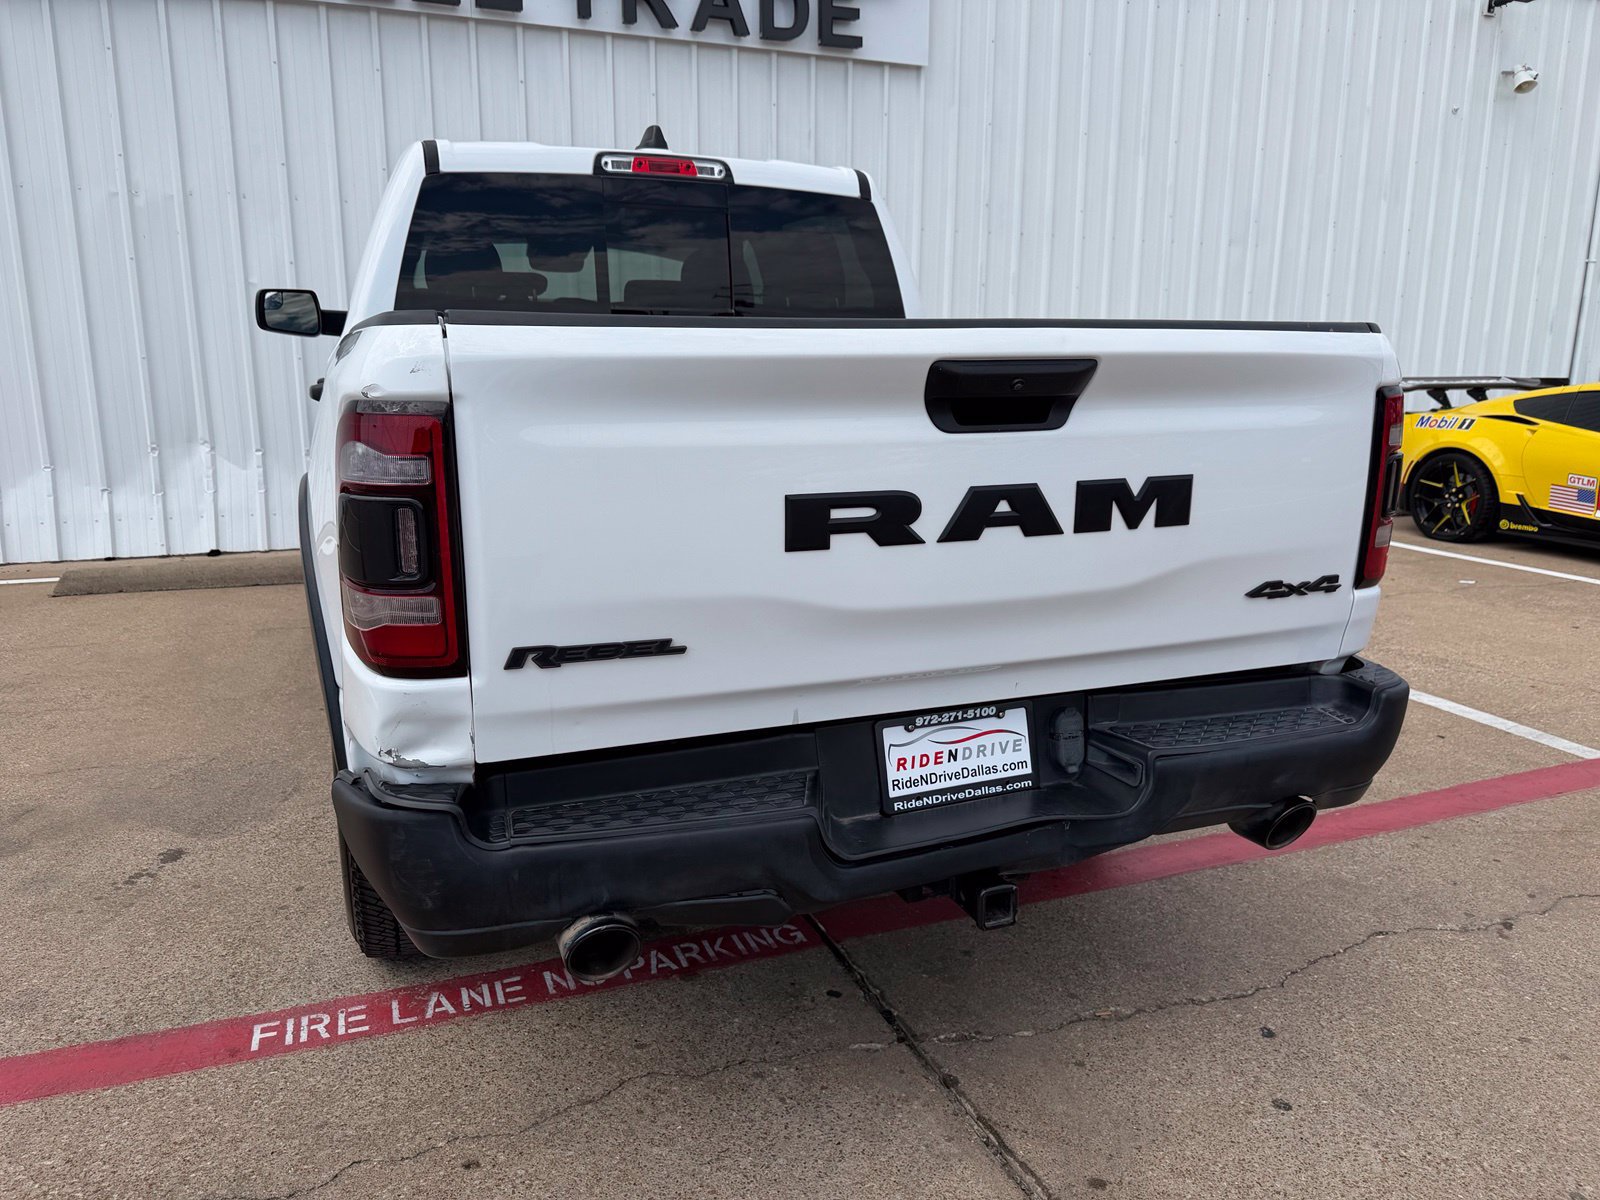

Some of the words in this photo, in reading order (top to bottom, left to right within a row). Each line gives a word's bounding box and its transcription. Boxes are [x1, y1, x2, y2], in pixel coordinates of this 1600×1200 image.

[577, 0, 863, 49] ADE
[1415, 415, 1459, 430] Mobil
[1569, 475, 1596, 488] GTLM
[785, 474, 1193, 552] RAM
[1509, 523, 1539, 533] brembo
[1244, 574, 1342, 599] 4x4
[503, 638, 688, 670] REBEL
[915, 706, 997, 727] 972-271-5100
[891, 760, 1029, 792] RideNDriveDallas.com
[893, 779, 1033, 812] RideNDriveDallas.com
[250, 1004, 371, 1052] FIRE
[391, 976, 527, 1025] LANE
[542, 966, 607, 995] N
